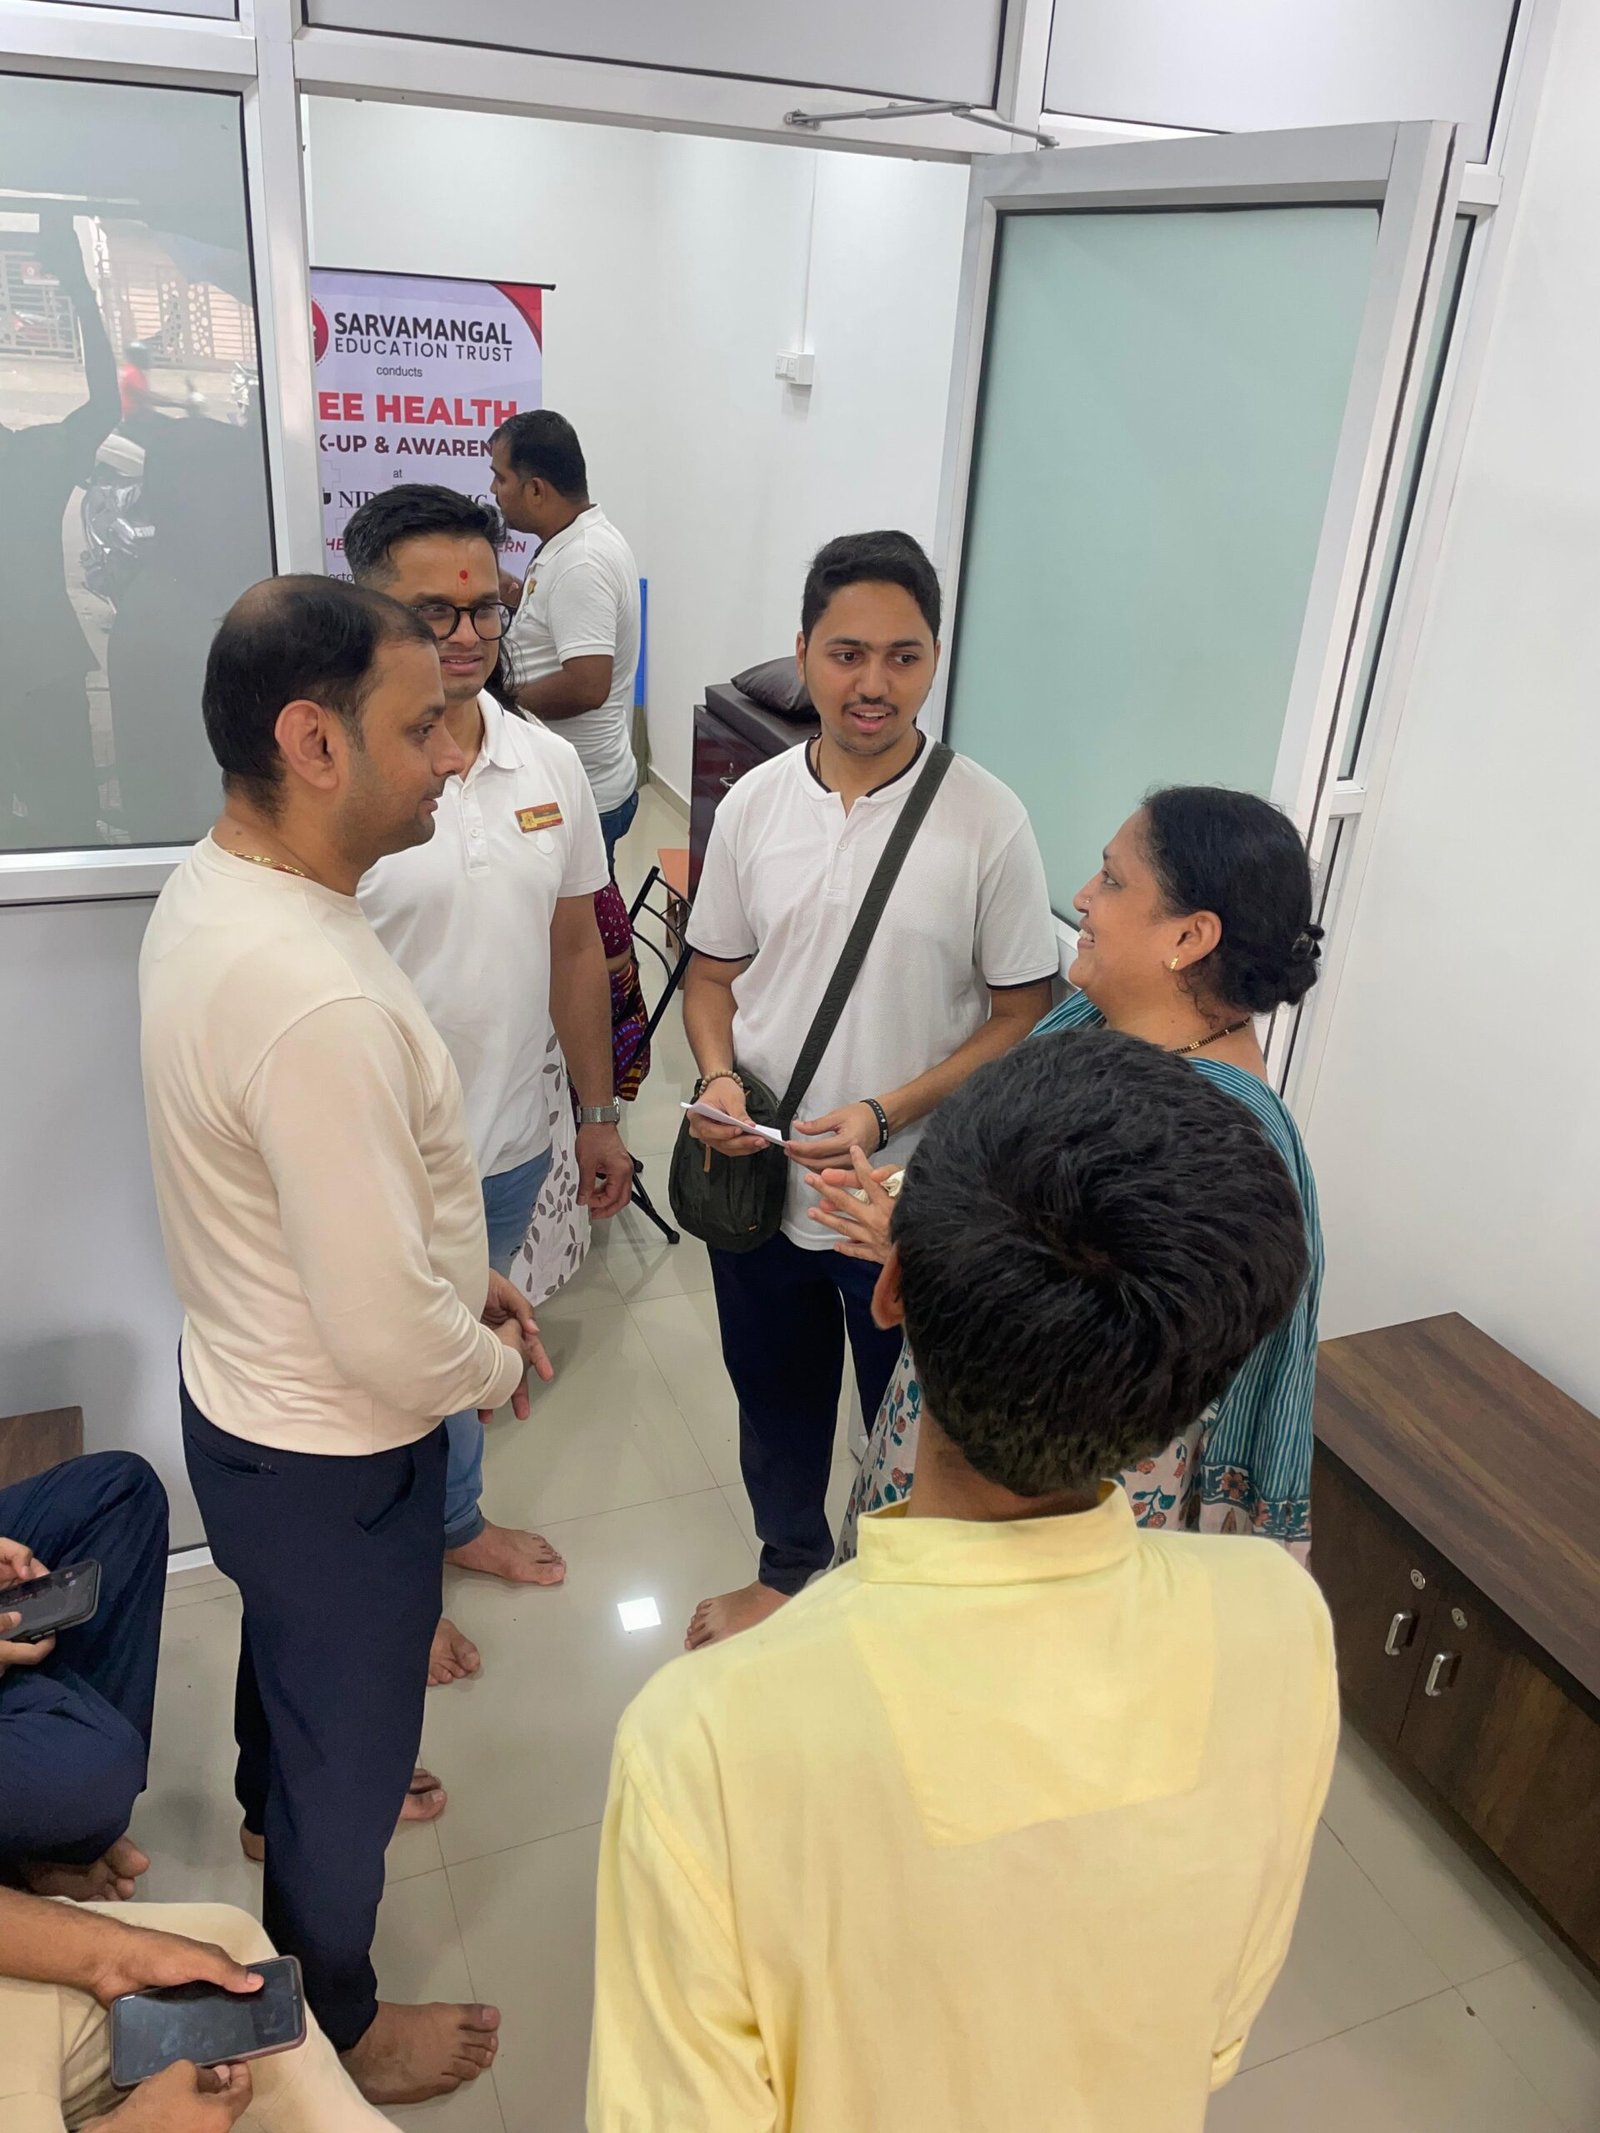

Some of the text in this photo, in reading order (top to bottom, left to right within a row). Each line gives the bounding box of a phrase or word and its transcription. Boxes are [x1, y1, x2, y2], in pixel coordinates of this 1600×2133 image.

[334, 312, 512, 345] SARVAMANGAL
[335, 337, 512, 362] EDUCATION TRUST
[376, 366, 423, 377] conducts
[376, 394, 517, 427] HEALTH
[374, 435, 389, 453] &
[393, 469, 402, 478] at
